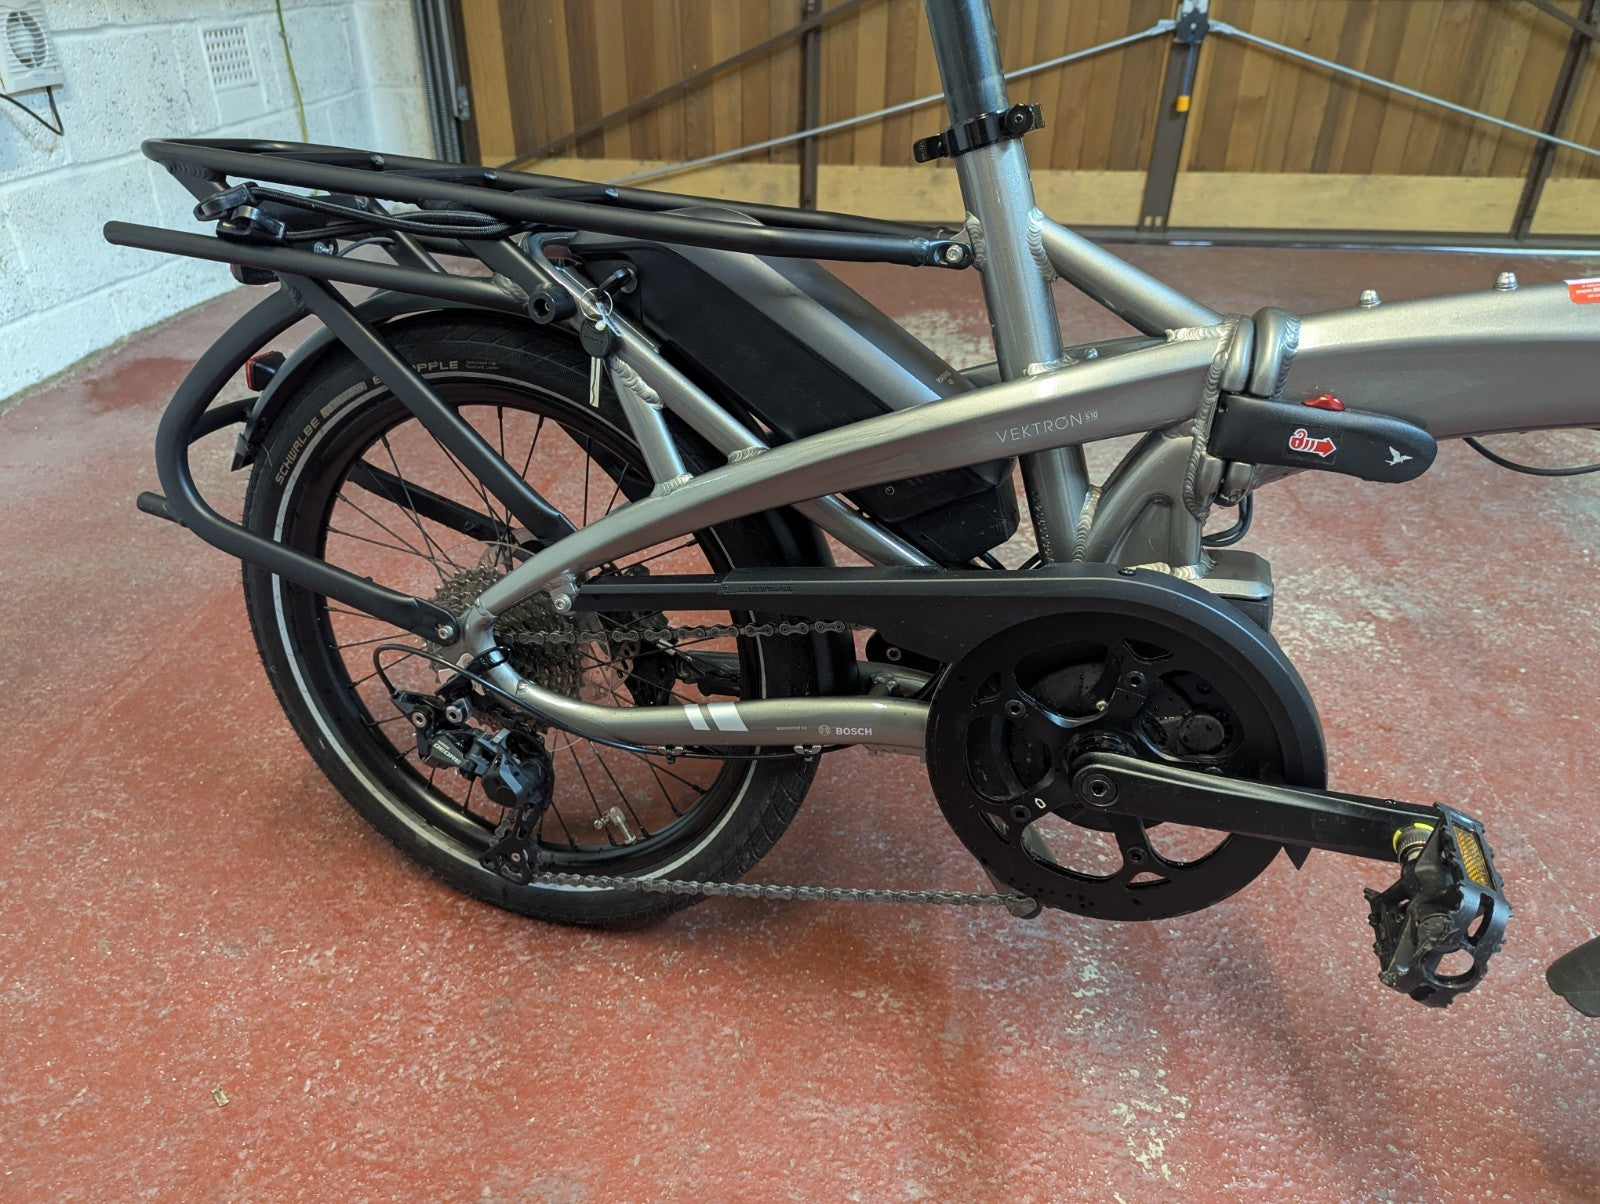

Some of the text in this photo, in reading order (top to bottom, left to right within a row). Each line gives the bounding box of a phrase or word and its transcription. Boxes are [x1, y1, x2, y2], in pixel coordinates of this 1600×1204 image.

[275, 361, 459, 485] SCHWALBE PPLE
[996, 412, 1082, 443] VEKTRON
[835, 727, 873, 736] BOSCH
